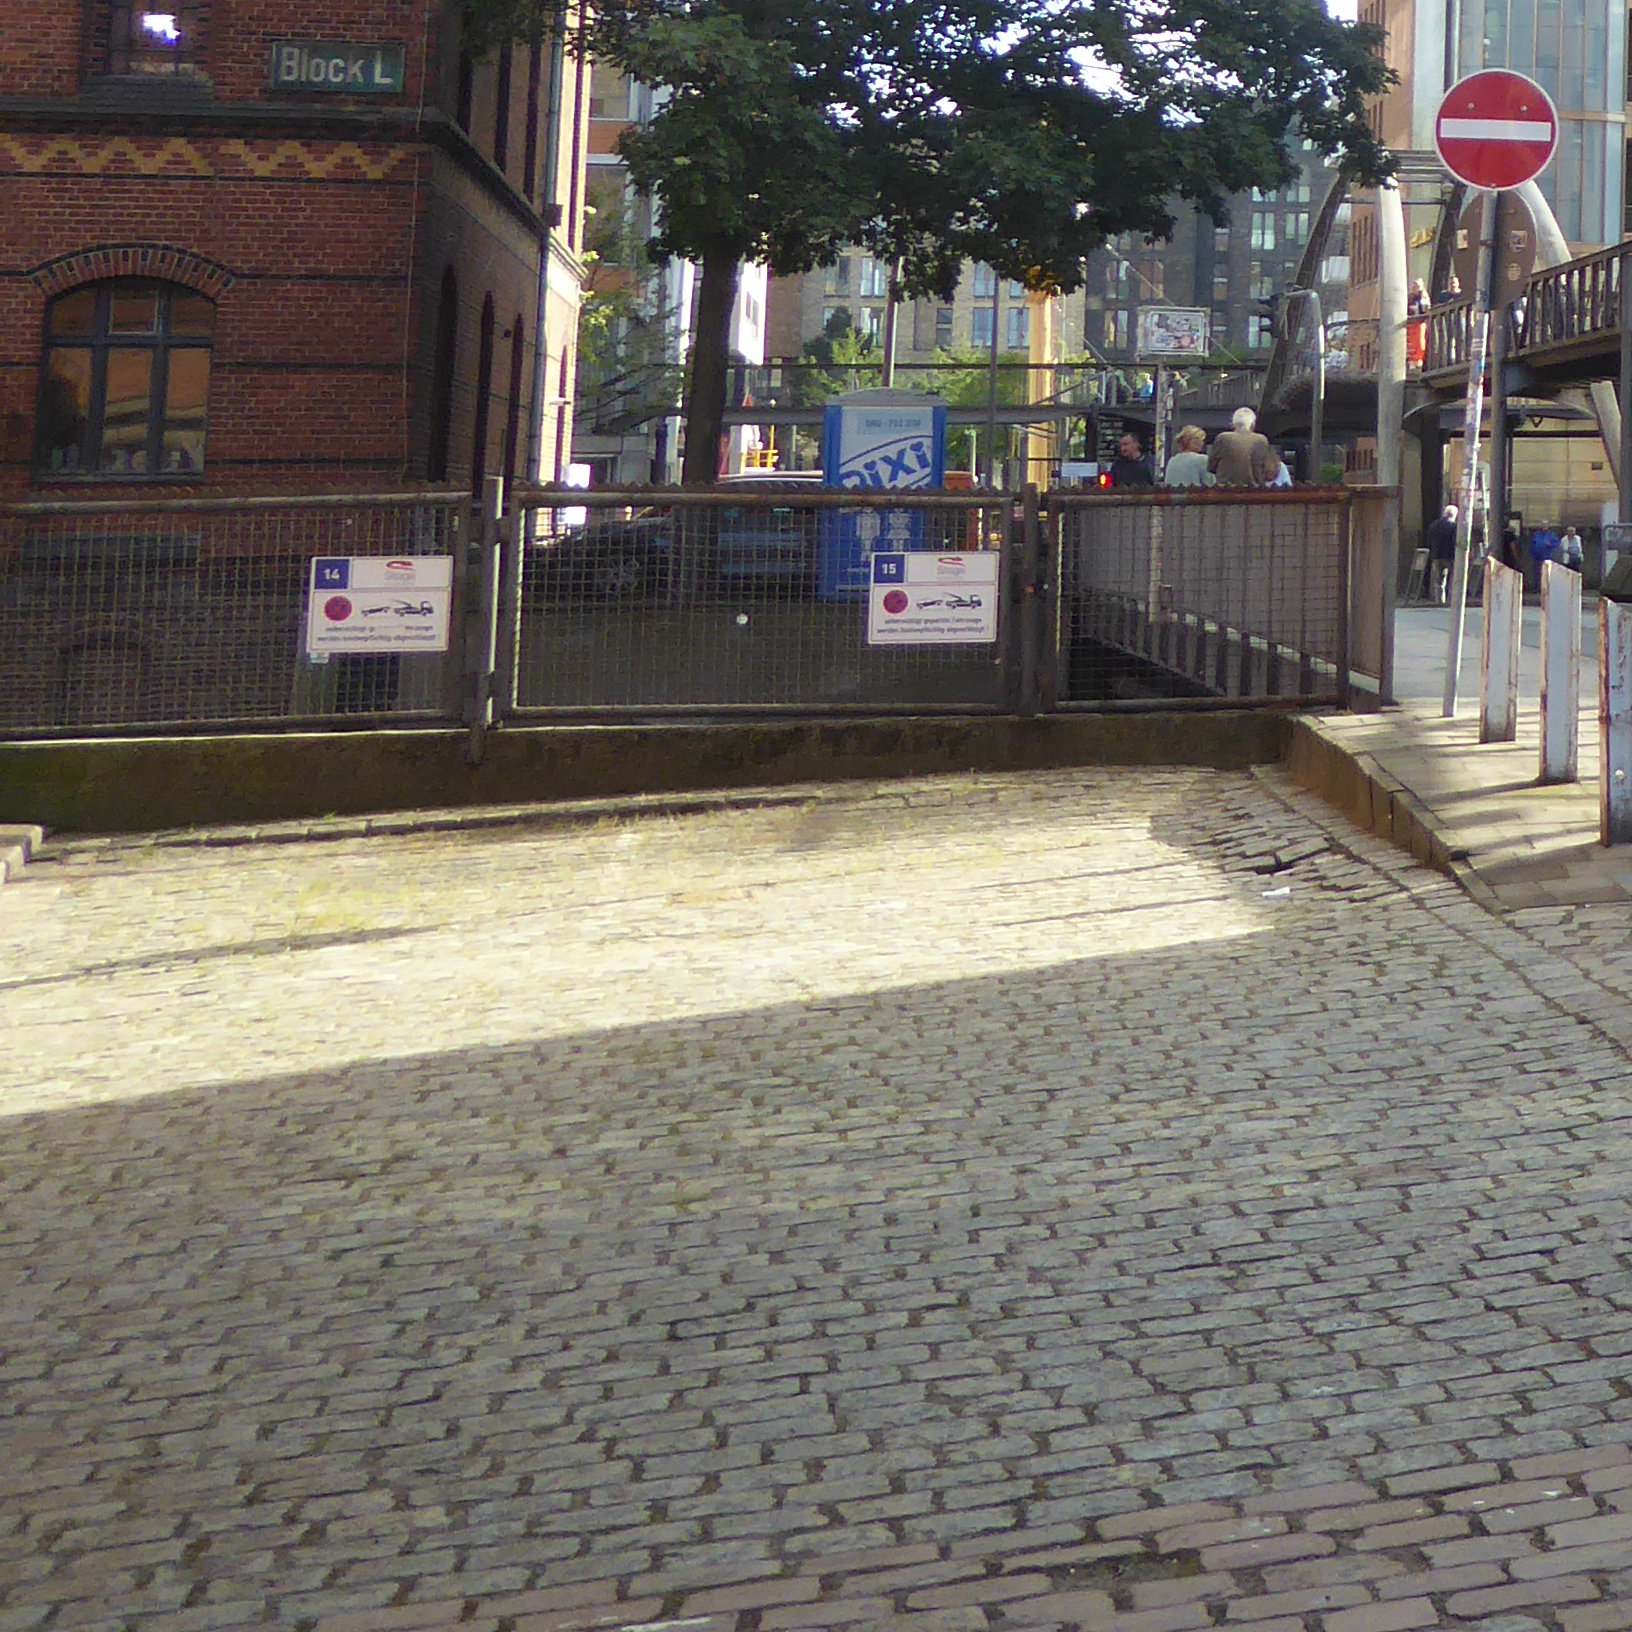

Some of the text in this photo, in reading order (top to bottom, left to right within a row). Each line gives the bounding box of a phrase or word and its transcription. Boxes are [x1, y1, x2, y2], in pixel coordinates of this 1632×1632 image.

[281, 46, 394, 84] Block L
[323, 568, 340, 580] 14
[882, 563, 897, 575] 15
